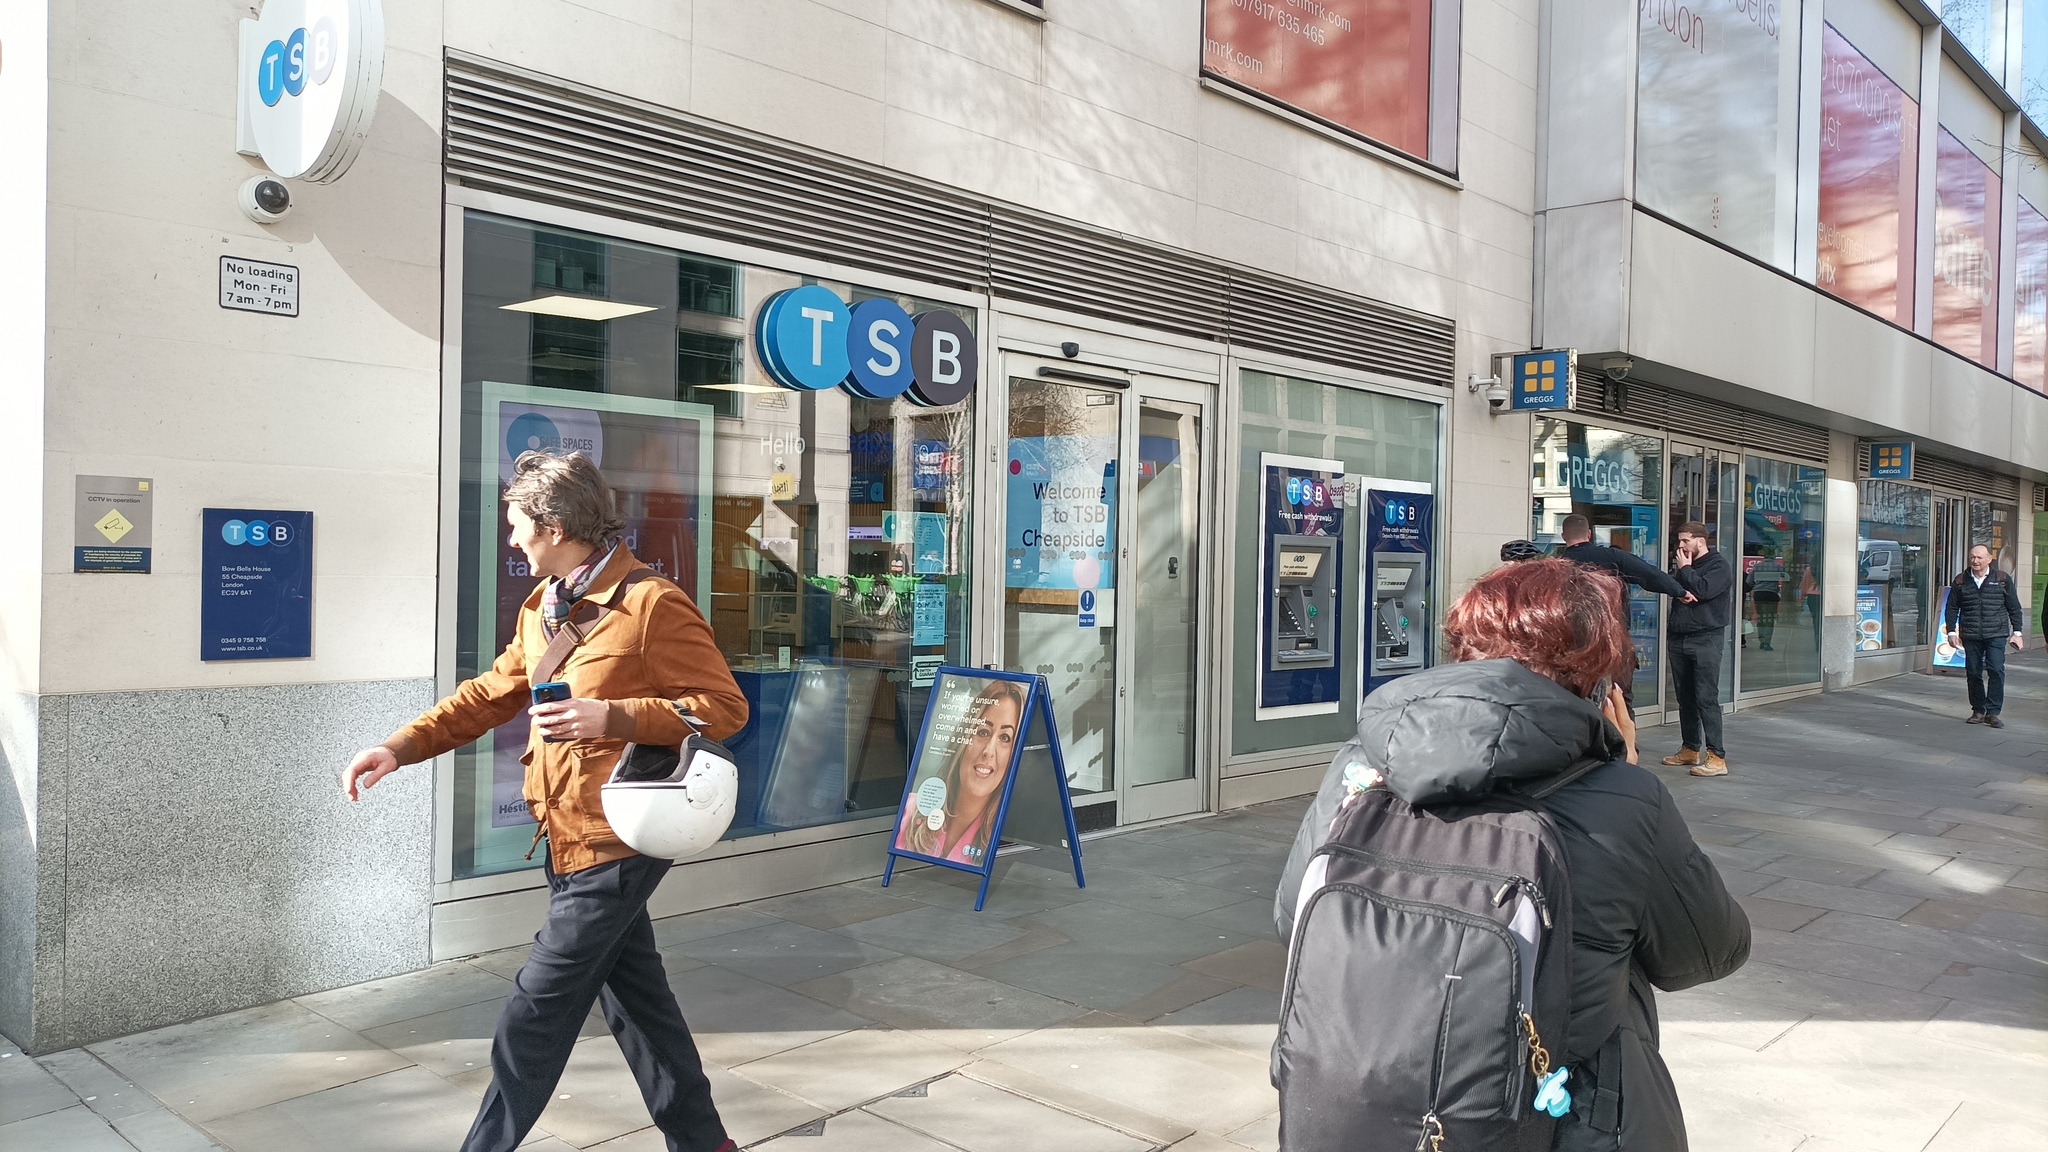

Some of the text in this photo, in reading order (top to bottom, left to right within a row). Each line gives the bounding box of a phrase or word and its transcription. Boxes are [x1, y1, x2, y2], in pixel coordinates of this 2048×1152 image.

[1278, 10, 1299, 34] 635
[1303, 23, 1325, 46] 465
[266, 30, 330, 91] TSB
[1832, 53, 1845, 94] to
[1847, 61, 1890, 130] 70,000
[226, 262, 293, 283] No loading
[234, 279, 260, 291] Mon
[270, 284, 286, 295] Fri
[801, 306, 962, 385] TSB
[1523, 395, 1554, 404] GREGGS
[562, 438, 593, 450] SPACES
[760, 432, 806, 456] Hello
[1557, 455, 1630, 495] GREGGS
[1033, 482, 1106, 500] Welcome
[1292, 484, 1322, 500] TSB
[1755, 483, 1801, 514] GREGGS
[1053, 505, 1105, 523] to TSB
[1279, 510, 1290, 518] Free
[1304, 513, 1332, 521] withdrawals
[1389, 505, 1414, 520] TSB
[230, 525, 288, 541] TSB
[1022, 529, 1105, 552] Cheapside
[944, 691, 951, 699] If
[976, 697, 1000, 706] unsure,
[942, 703, 969, 714] worried
[938, 713, 987, 726] overwhelmed,
[936, 724, 978, 736] come in and
[932, 731, 950, 742] have
[956, 736, 974, 746] chat.
